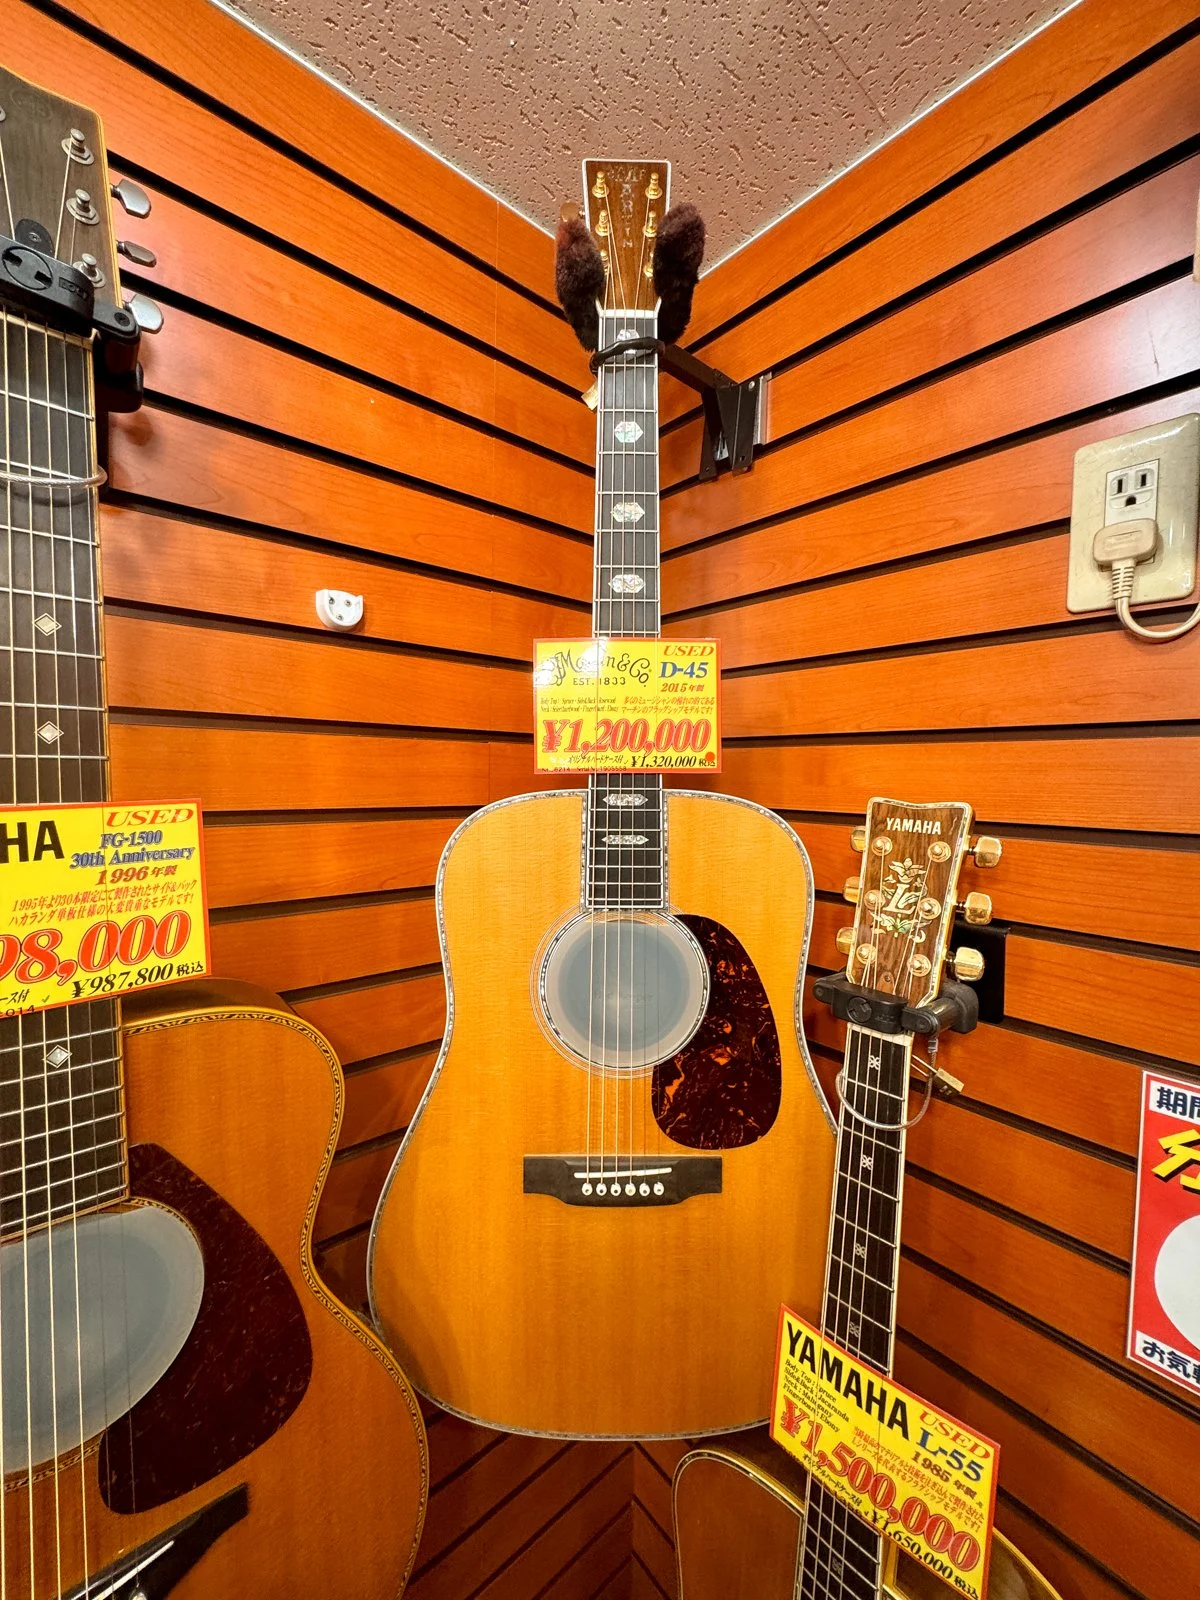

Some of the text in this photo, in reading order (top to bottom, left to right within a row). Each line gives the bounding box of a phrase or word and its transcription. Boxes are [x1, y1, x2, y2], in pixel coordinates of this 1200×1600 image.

[663, 645, 715, 657] USED
[573, 676, 626, 686] EST. 1833
[658, 661, 709, 679] D-45
[541, 717, 712, 759] ¥1,200,000
[631, 755, 697, 767] ¥1,320,000
[106, 808, 194, 828] USED
[886, 817, 942, 835] YAMAHA
[99, 829, 164, 849] FG-1500
[69, 846, 196, 869] 30th Anniversary
[71, 960, 204, 999] ¥987,800 税込
[785, 1358, 799, 1374] Body
[801, 1370, 813, 1383] Top
[1141, 1339, 1200, 1385] お気
[783, 1375, 799, 1390] Neck
[786, 1319, 910, 1441] YAMAHA
[784, 1366, 815, 1395] Side&Back
[818, 1394, 850, 1423] Jacaranda
[819, 1413, 841, 1433] Ebony
[919, 1409, 991, 1460] USED
[916, 1427, 985, 1482] L-55
[780, 1394, 981, 1573] ¥1,500,000
[871, 1508, 954, 1580] ¥1,650,000
